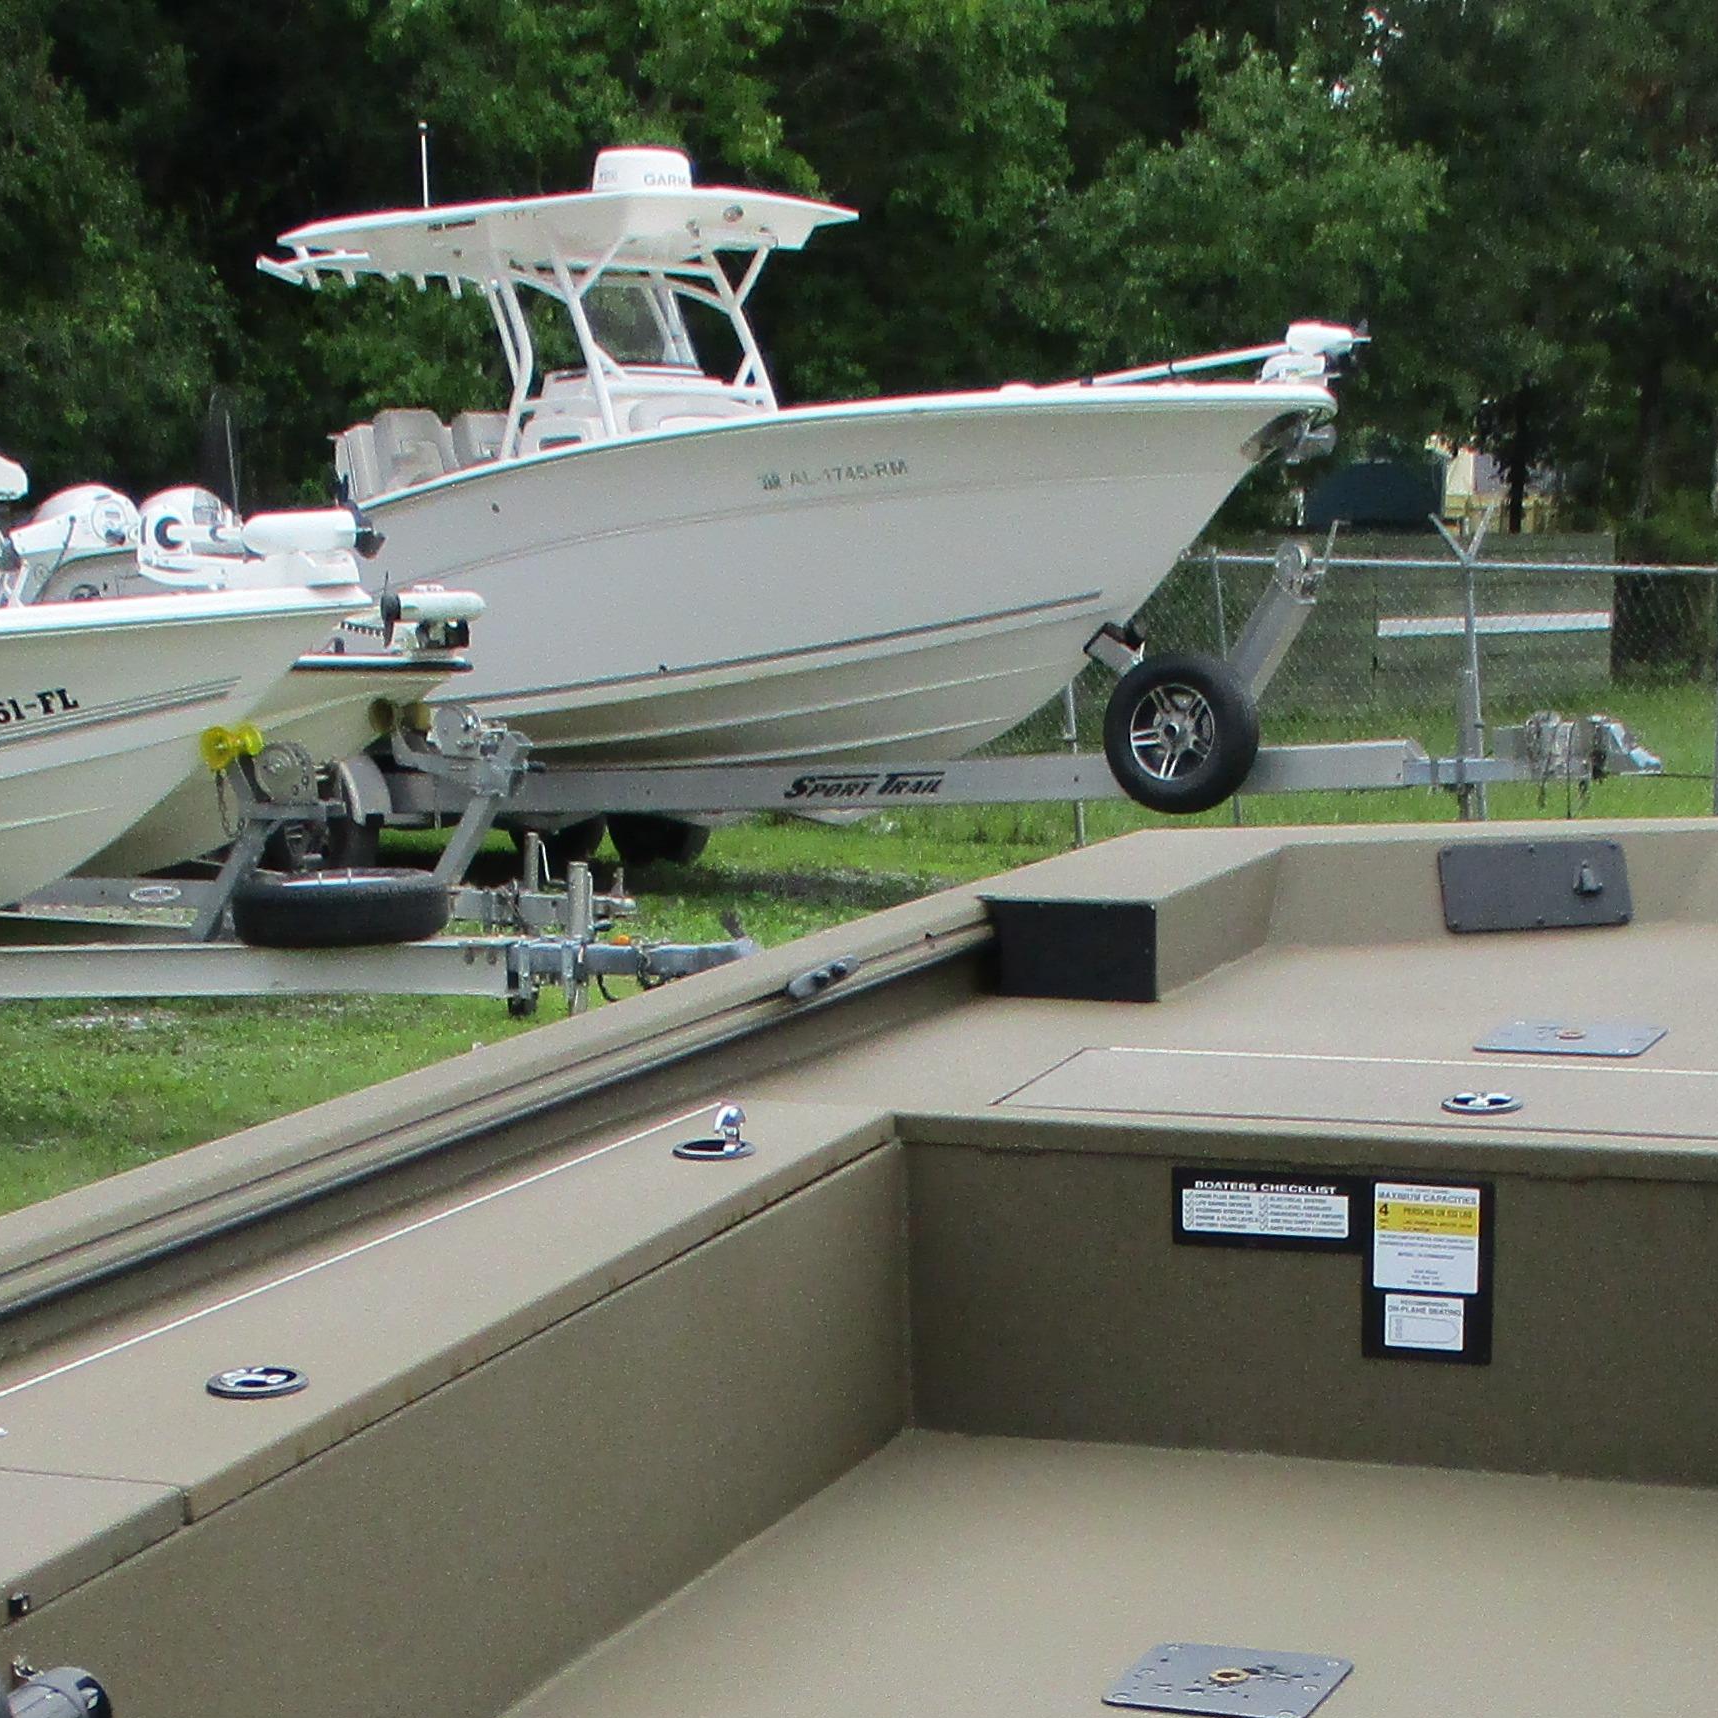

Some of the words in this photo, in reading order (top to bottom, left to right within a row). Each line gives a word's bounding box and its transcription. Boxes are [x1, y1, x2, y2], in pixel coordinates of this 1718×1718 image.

[1194, 1181, 1257, 1191] BOATERS
[1260, 1183, 1337, 1195] CHECKLIST
[1377, 1191, 1420, 1200] MAXIMUM
[1422, 1194, 1477, 1205] CAPACITIES
[1378, 1203, 1389, 1216] 4
